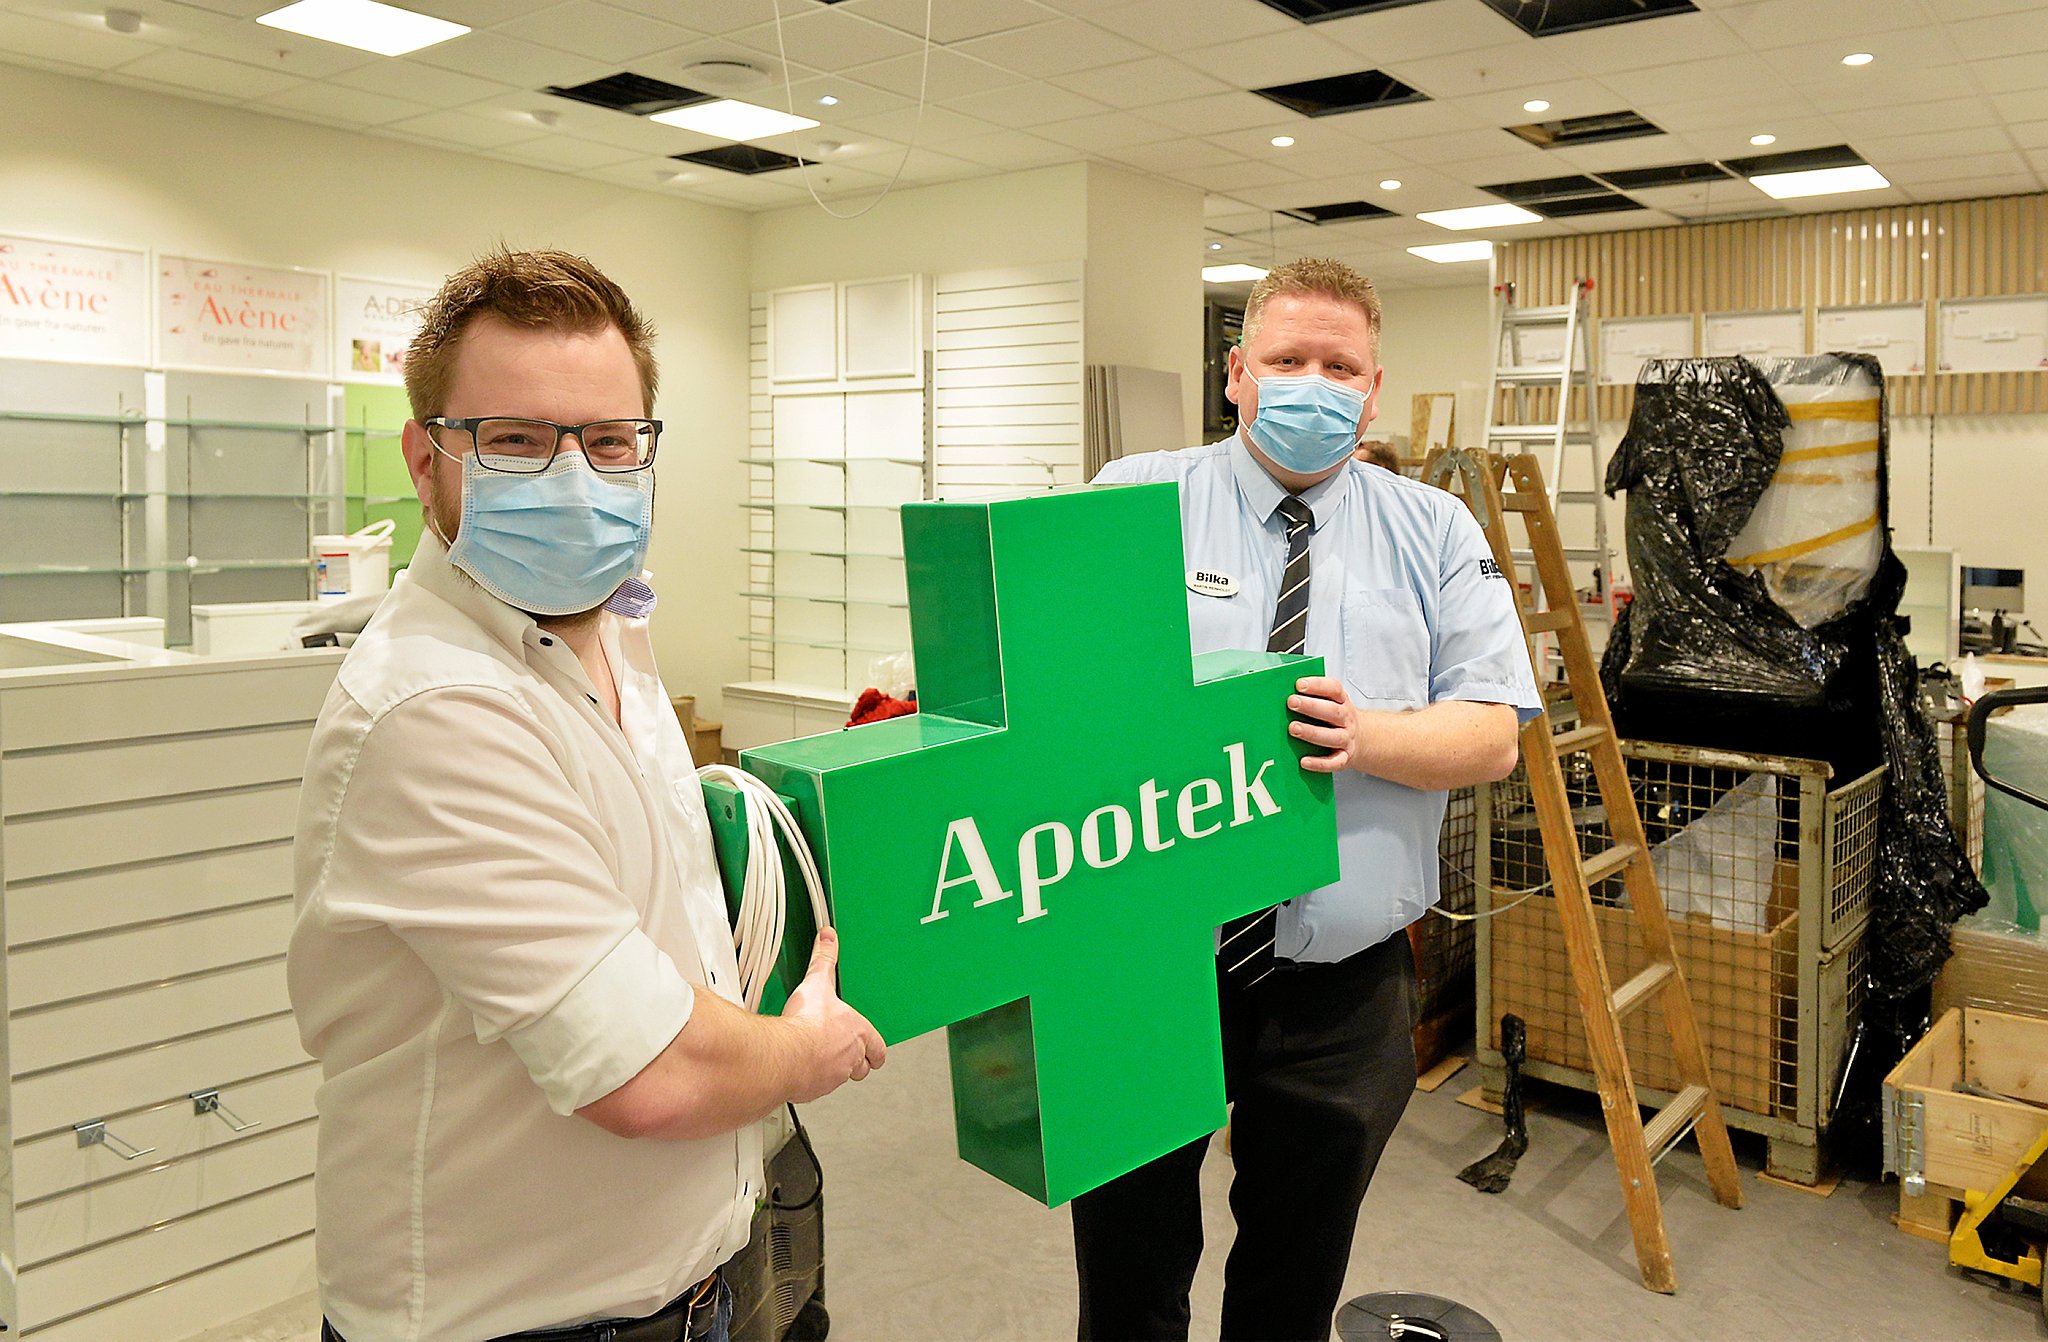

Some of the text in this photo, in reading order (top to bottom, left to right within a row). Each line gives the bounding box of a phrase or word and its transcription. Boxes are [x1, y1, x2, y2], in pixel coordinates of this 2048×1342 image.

[0, 272, 109, 315] Avène
[193, 280, 301, 302] EAU THERMALE
[197, 295, 298, 333] Avène
[1196, 571, 1229, 586] Bilka
[920, 742, 1282, 924] Apotek
